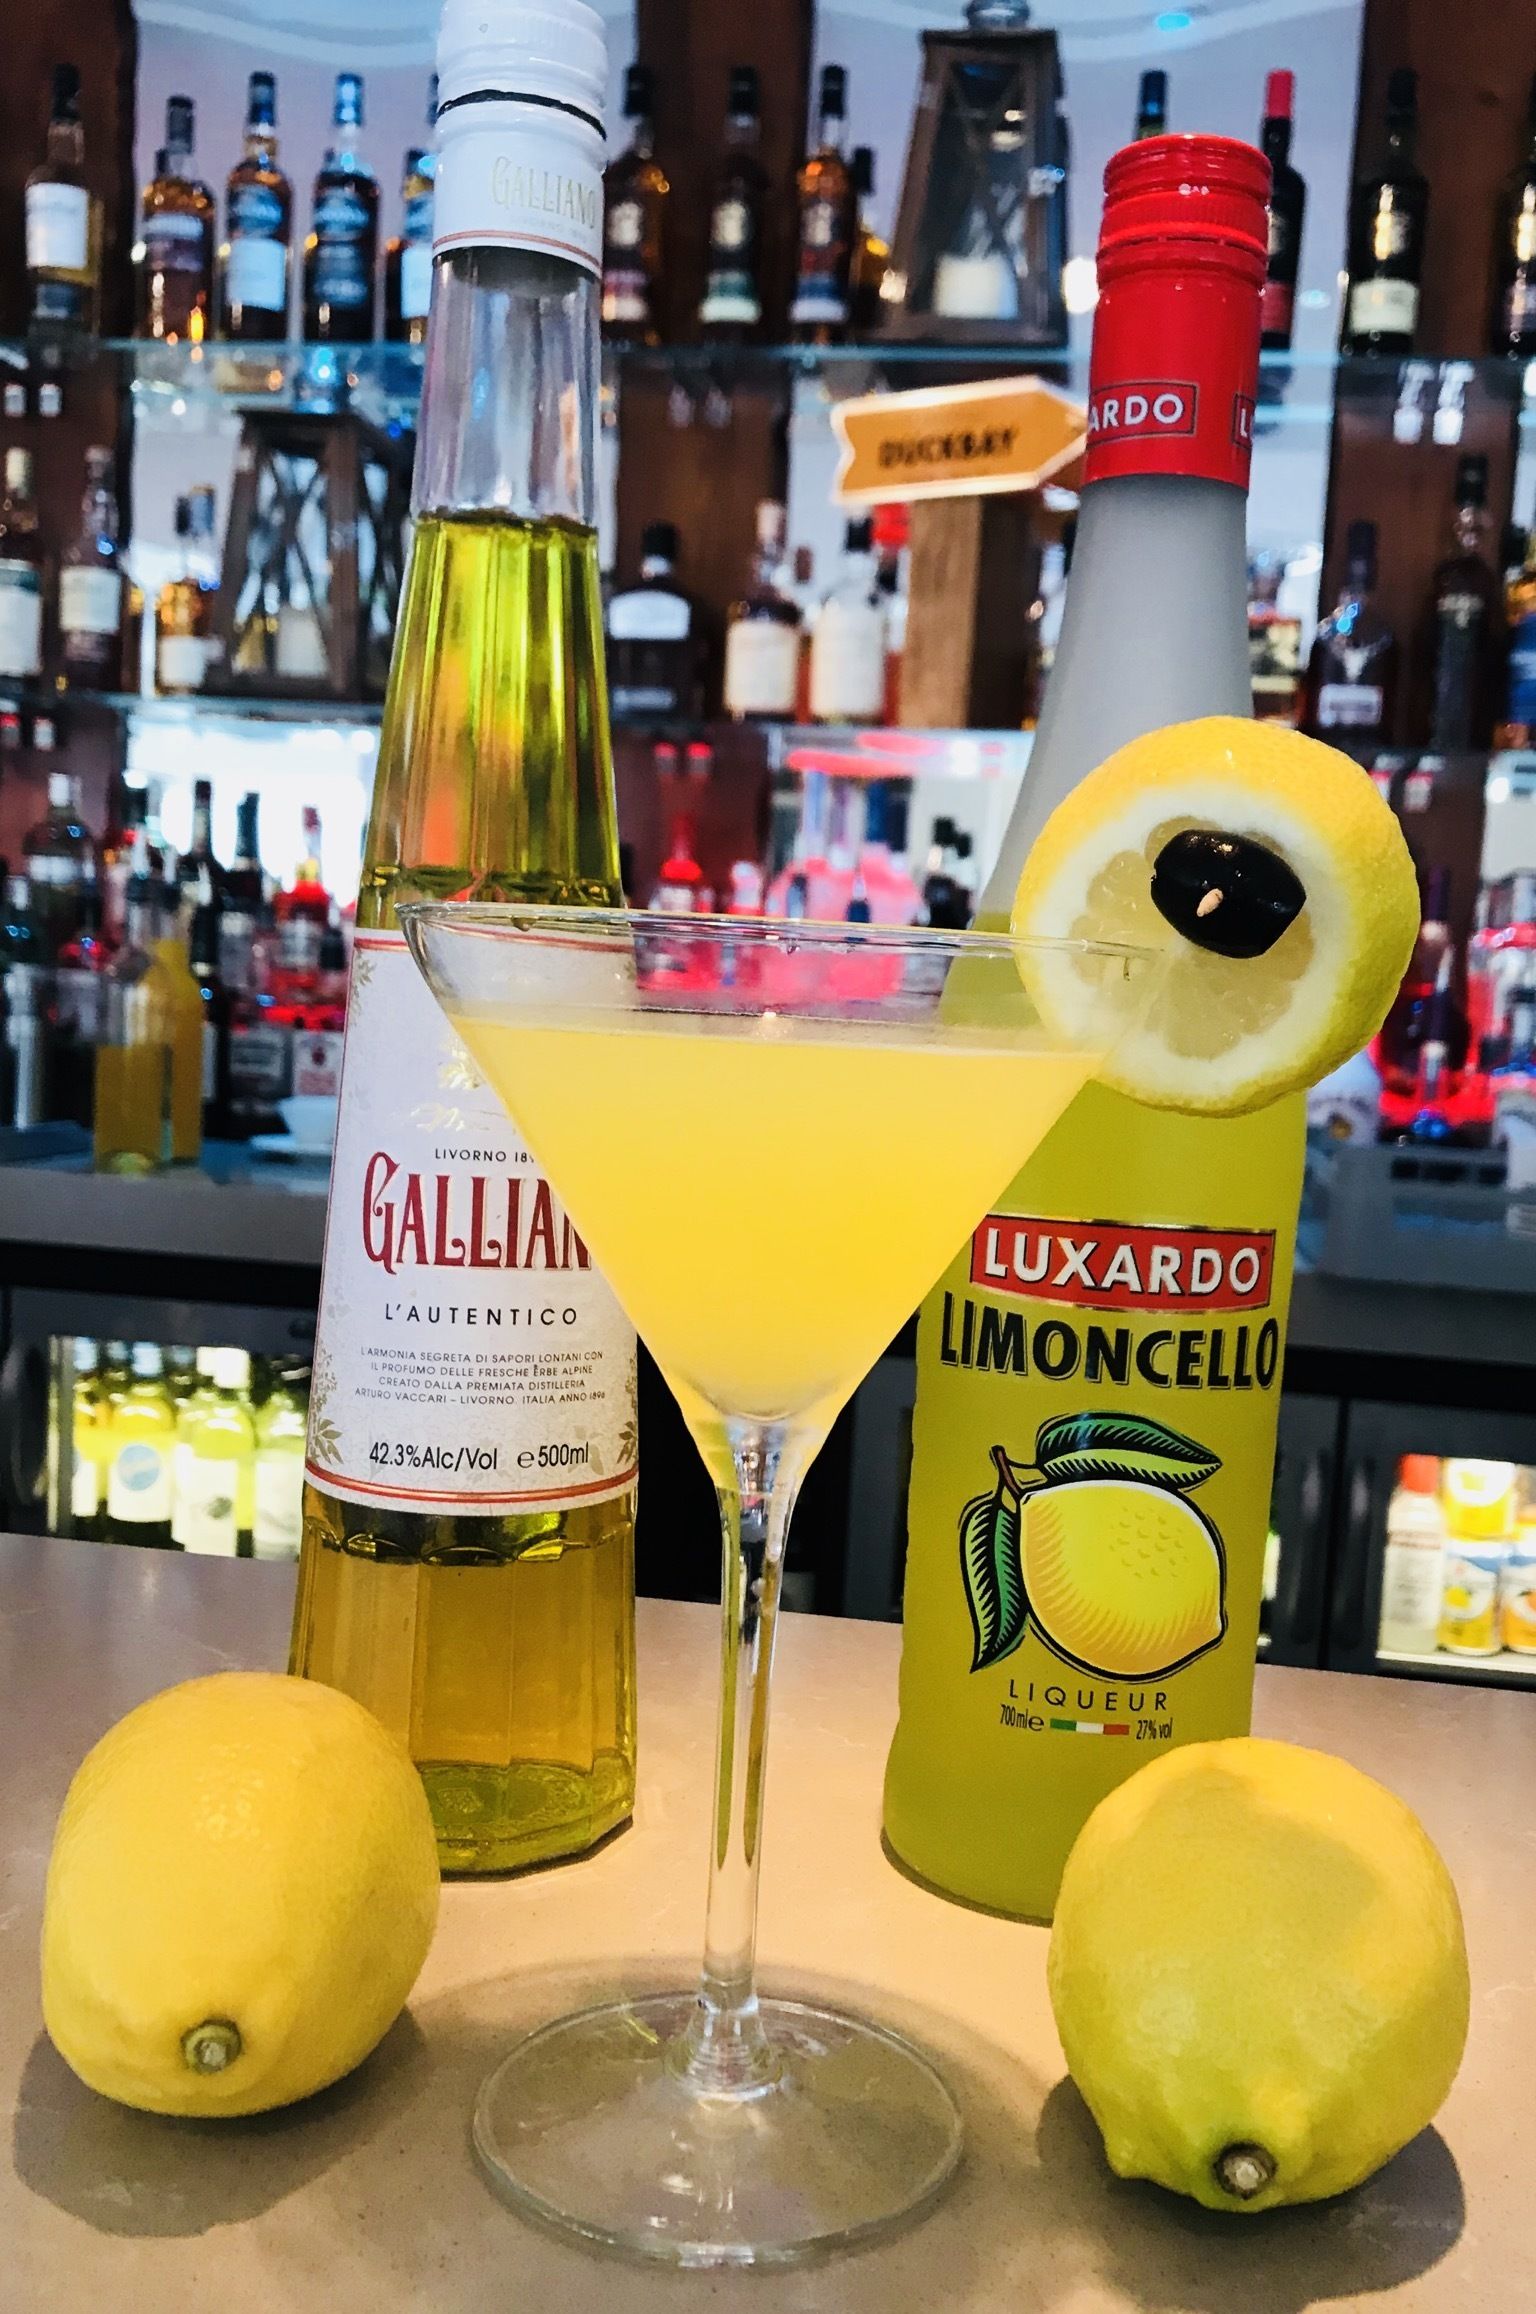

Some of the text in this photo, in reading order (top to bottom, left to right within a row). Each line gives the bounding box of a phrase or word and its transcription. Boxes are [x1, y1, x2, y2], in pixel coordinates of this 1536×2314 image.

[491, 155, 597, 229] GALLIANO
[435, 1148, 507, 1162] LIVORNO
[984, 1227, 1262, 1296] LUXARDO
[385, 1303, 577, 1326] L'AUTENTICO
[940, 1290, 1280, 1390] LIMONCELLO
[420, 1351, 471, 1363] SEGRETA
[476, 1354, 488, 1364] DI
[492, 1354, 535, 1364] SAPORI
[538, 1353, 582, 1363] LONTANI
[584, 1351, 603, 1361] CON
[370, 1362, 379, 1371] IL
[382, 1362, 436, 1375] PROFUMO
[440, 1366, 474, 1377] DELLE
[478, 1367, 529, 1378] FRESCHE
[562, 1365, 593, 1375] ALPINE
[378, 1376, 586, 1391] CREATO DALLA PREMIATA DISTILLERIA
[354, 1387, 391, 1400] ARTURO
[395, 1391, 447, 1403] VACCARI
[522, 1395, 556, 1405] ITALIA
[559, 1392, 587, 1403] ANNO
[1009, 1679, 1168, 1712] LIQUEUR
